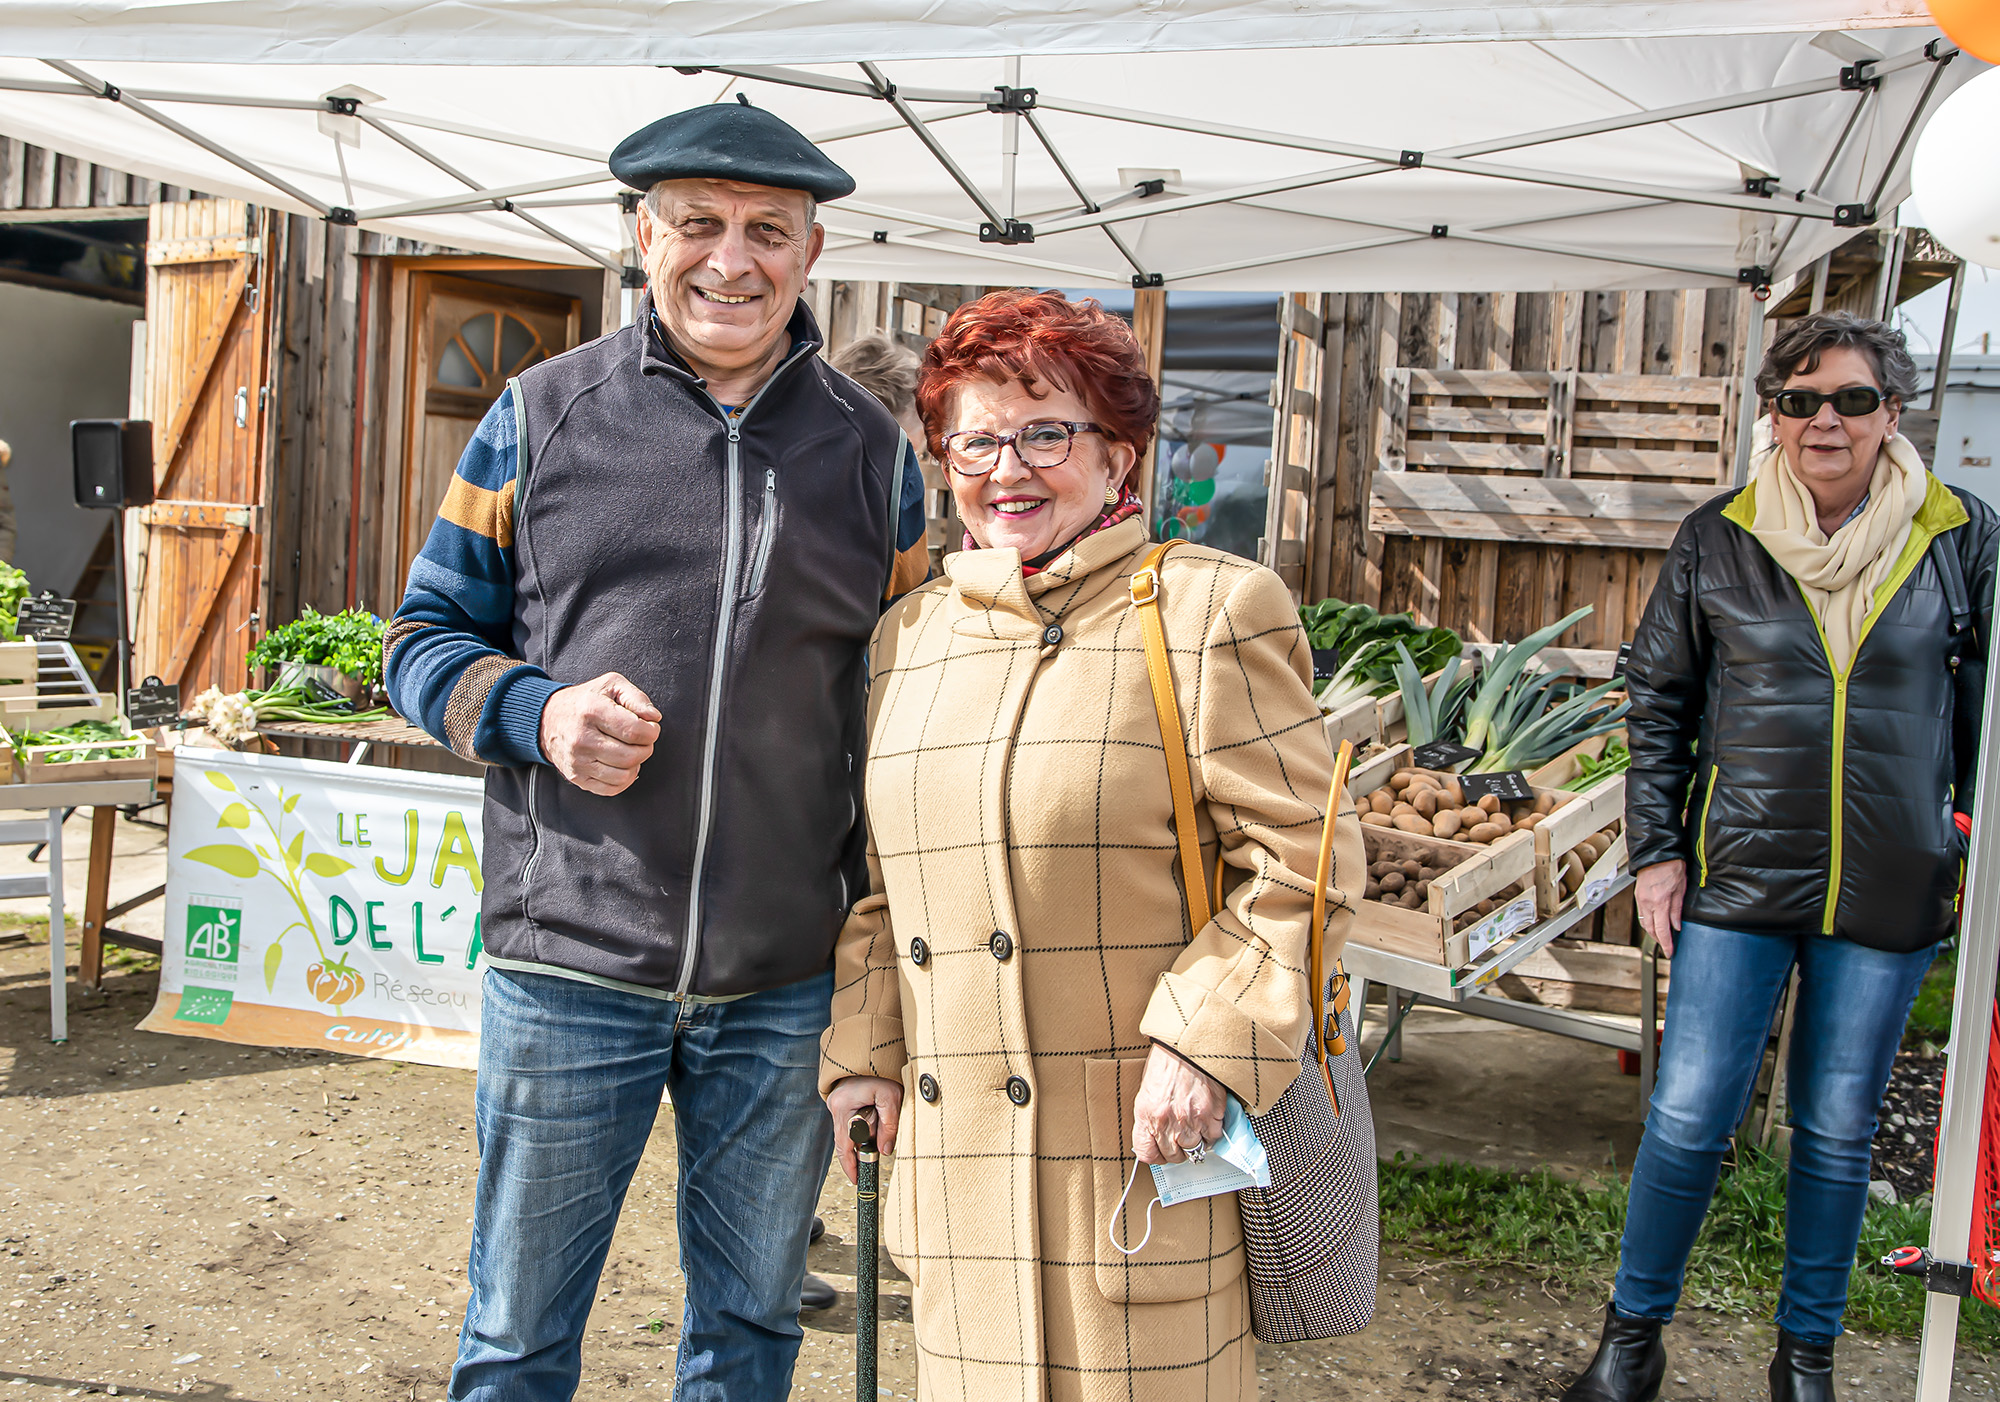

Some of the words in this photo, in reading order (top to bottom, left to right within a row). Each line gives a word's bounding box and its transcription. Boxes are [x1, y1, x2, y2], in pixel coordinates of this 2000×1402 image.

[337, 812, 371, 848] LE
[188, 922, 231, 959] AB
[329, 895, 393, 951] DE
[184, 959, 238, 972] AGRICULTURE
[184, 967, 237, 981] BIOLOGIQUE
[373, 972, 468, 1010] Réseau
